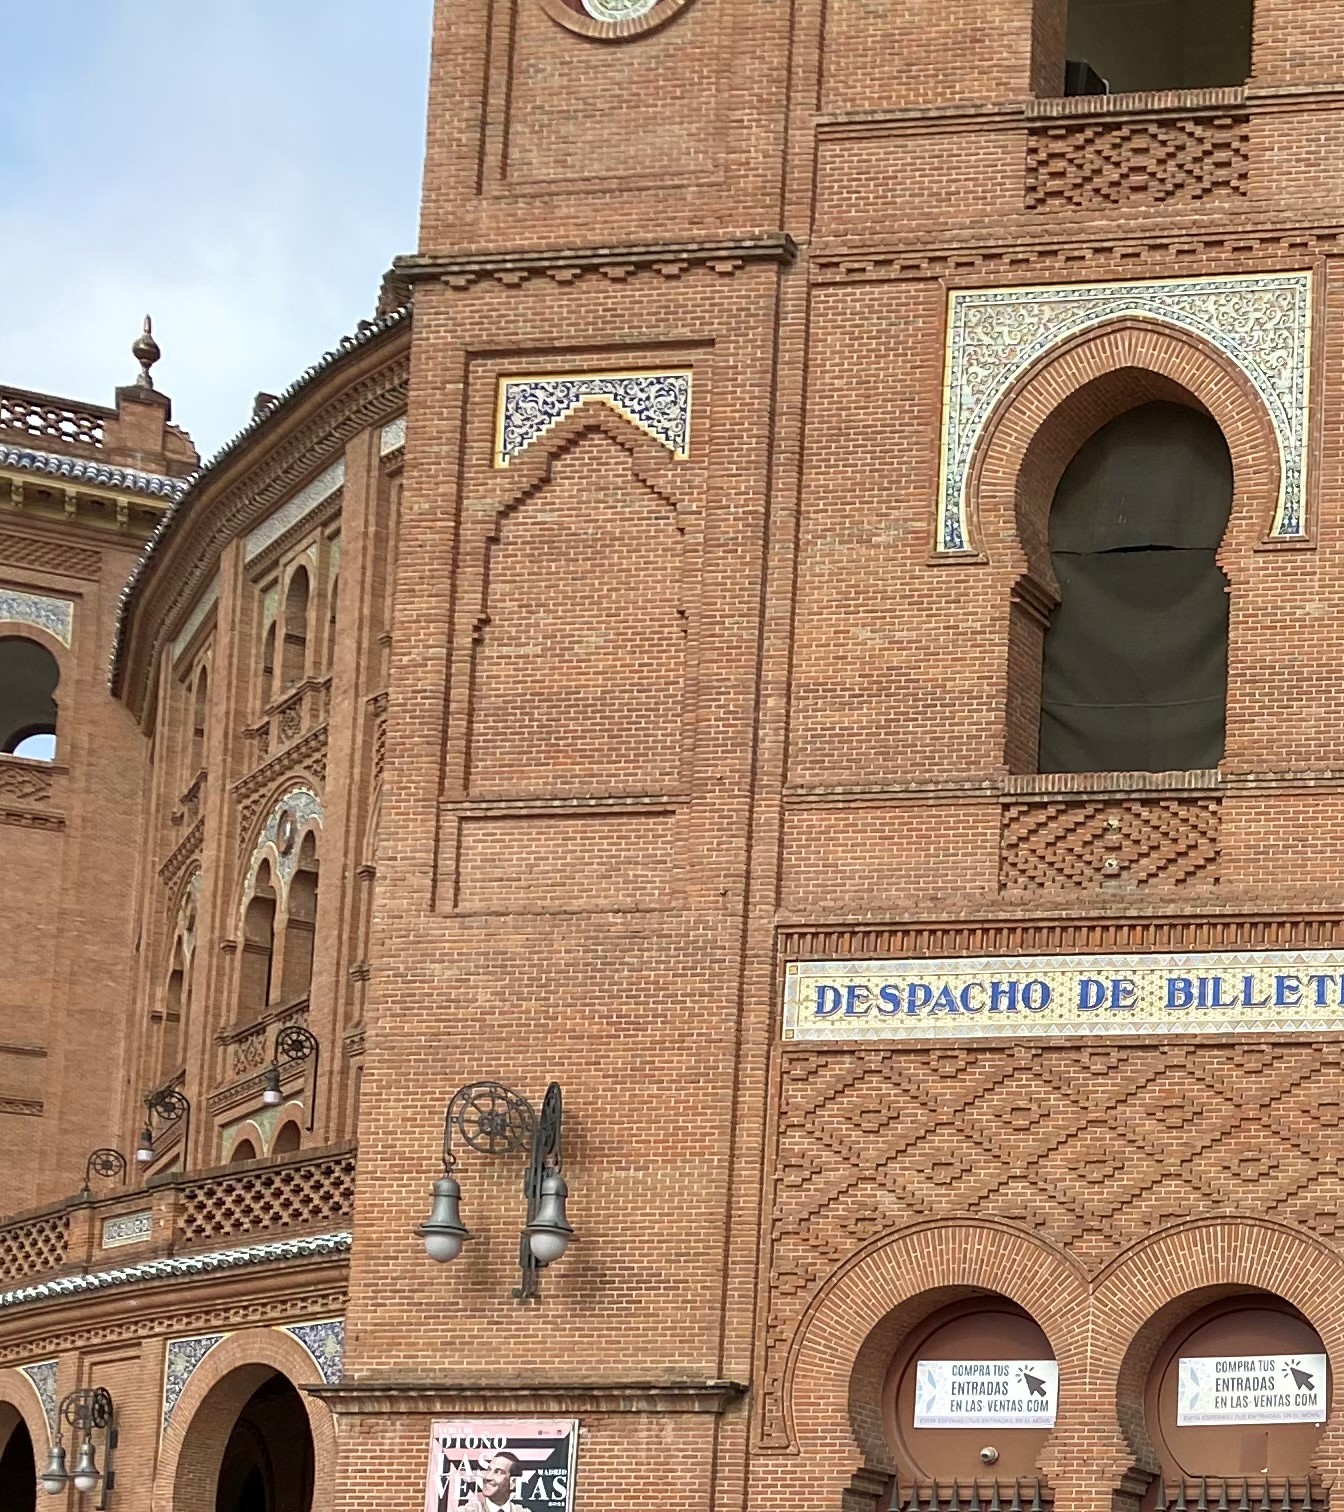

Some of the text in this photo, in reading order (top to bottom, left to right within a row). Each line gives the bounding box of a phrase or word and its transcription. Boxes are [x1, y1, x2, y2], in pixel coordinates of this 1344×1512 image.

[814, 980, 1052, 1019] DESPACHO
[1078, 977, 1137, 1012] DE
[952, 1365, 1009, 1376] COMPRA TUS
[1215, 1360, 1275, 1373] COMPRA TUS
[951, 1381, 1009, 1396] ENTRADAS
[1215, 1376, 1275, 1392] ENTRADAS
[950, 1400, 959, 1412] EN
[1215, 1396, 1227, 1409] EN
